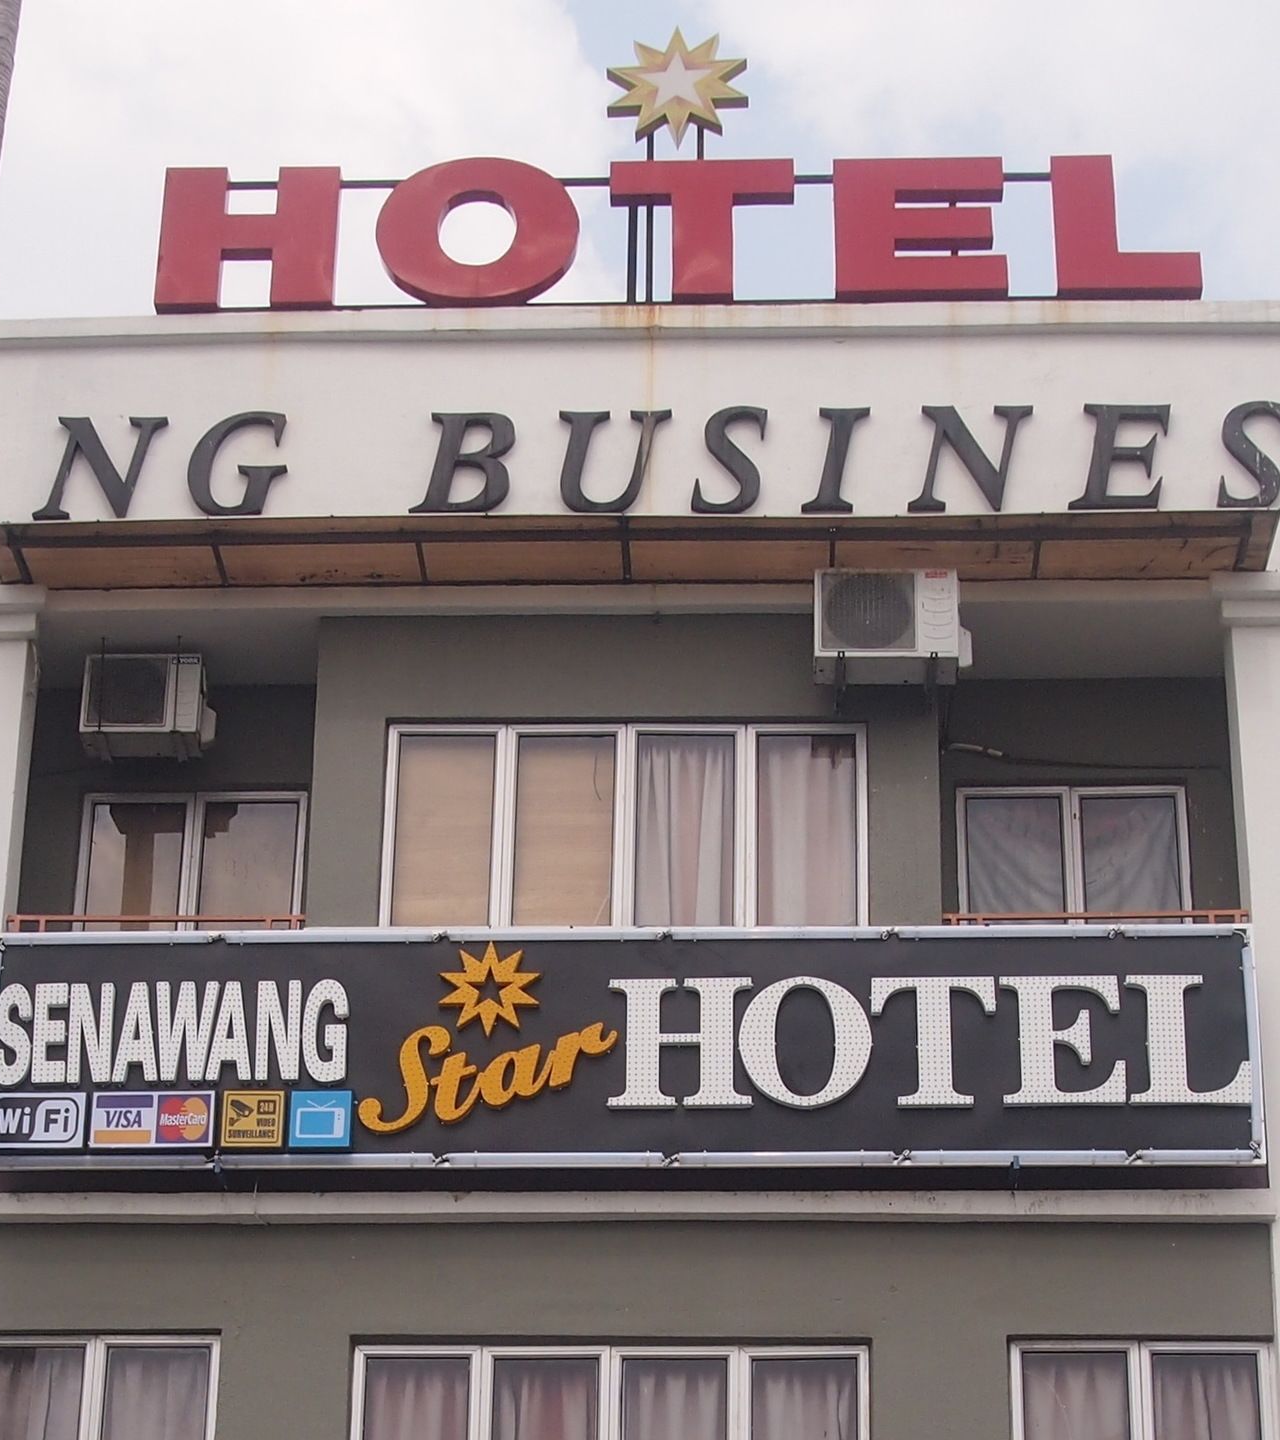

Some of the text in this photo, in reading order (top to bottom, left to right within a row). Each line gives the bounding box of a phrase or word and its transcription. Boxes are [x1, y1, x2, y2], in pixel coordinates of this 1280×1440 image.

[154, 155, 1202, 314] HOTEL
[357, 1021, 617, 1137] Star
[607, 974, 1252, 1110] HOTEL
[104, 1109, 143, 1129] VISA
[159, 1111, 208, 1127] MasterCard
[256, 1117, 276, 1127] VIDEO
[227, 1129, 276, 1139] SURVEILLANCE
